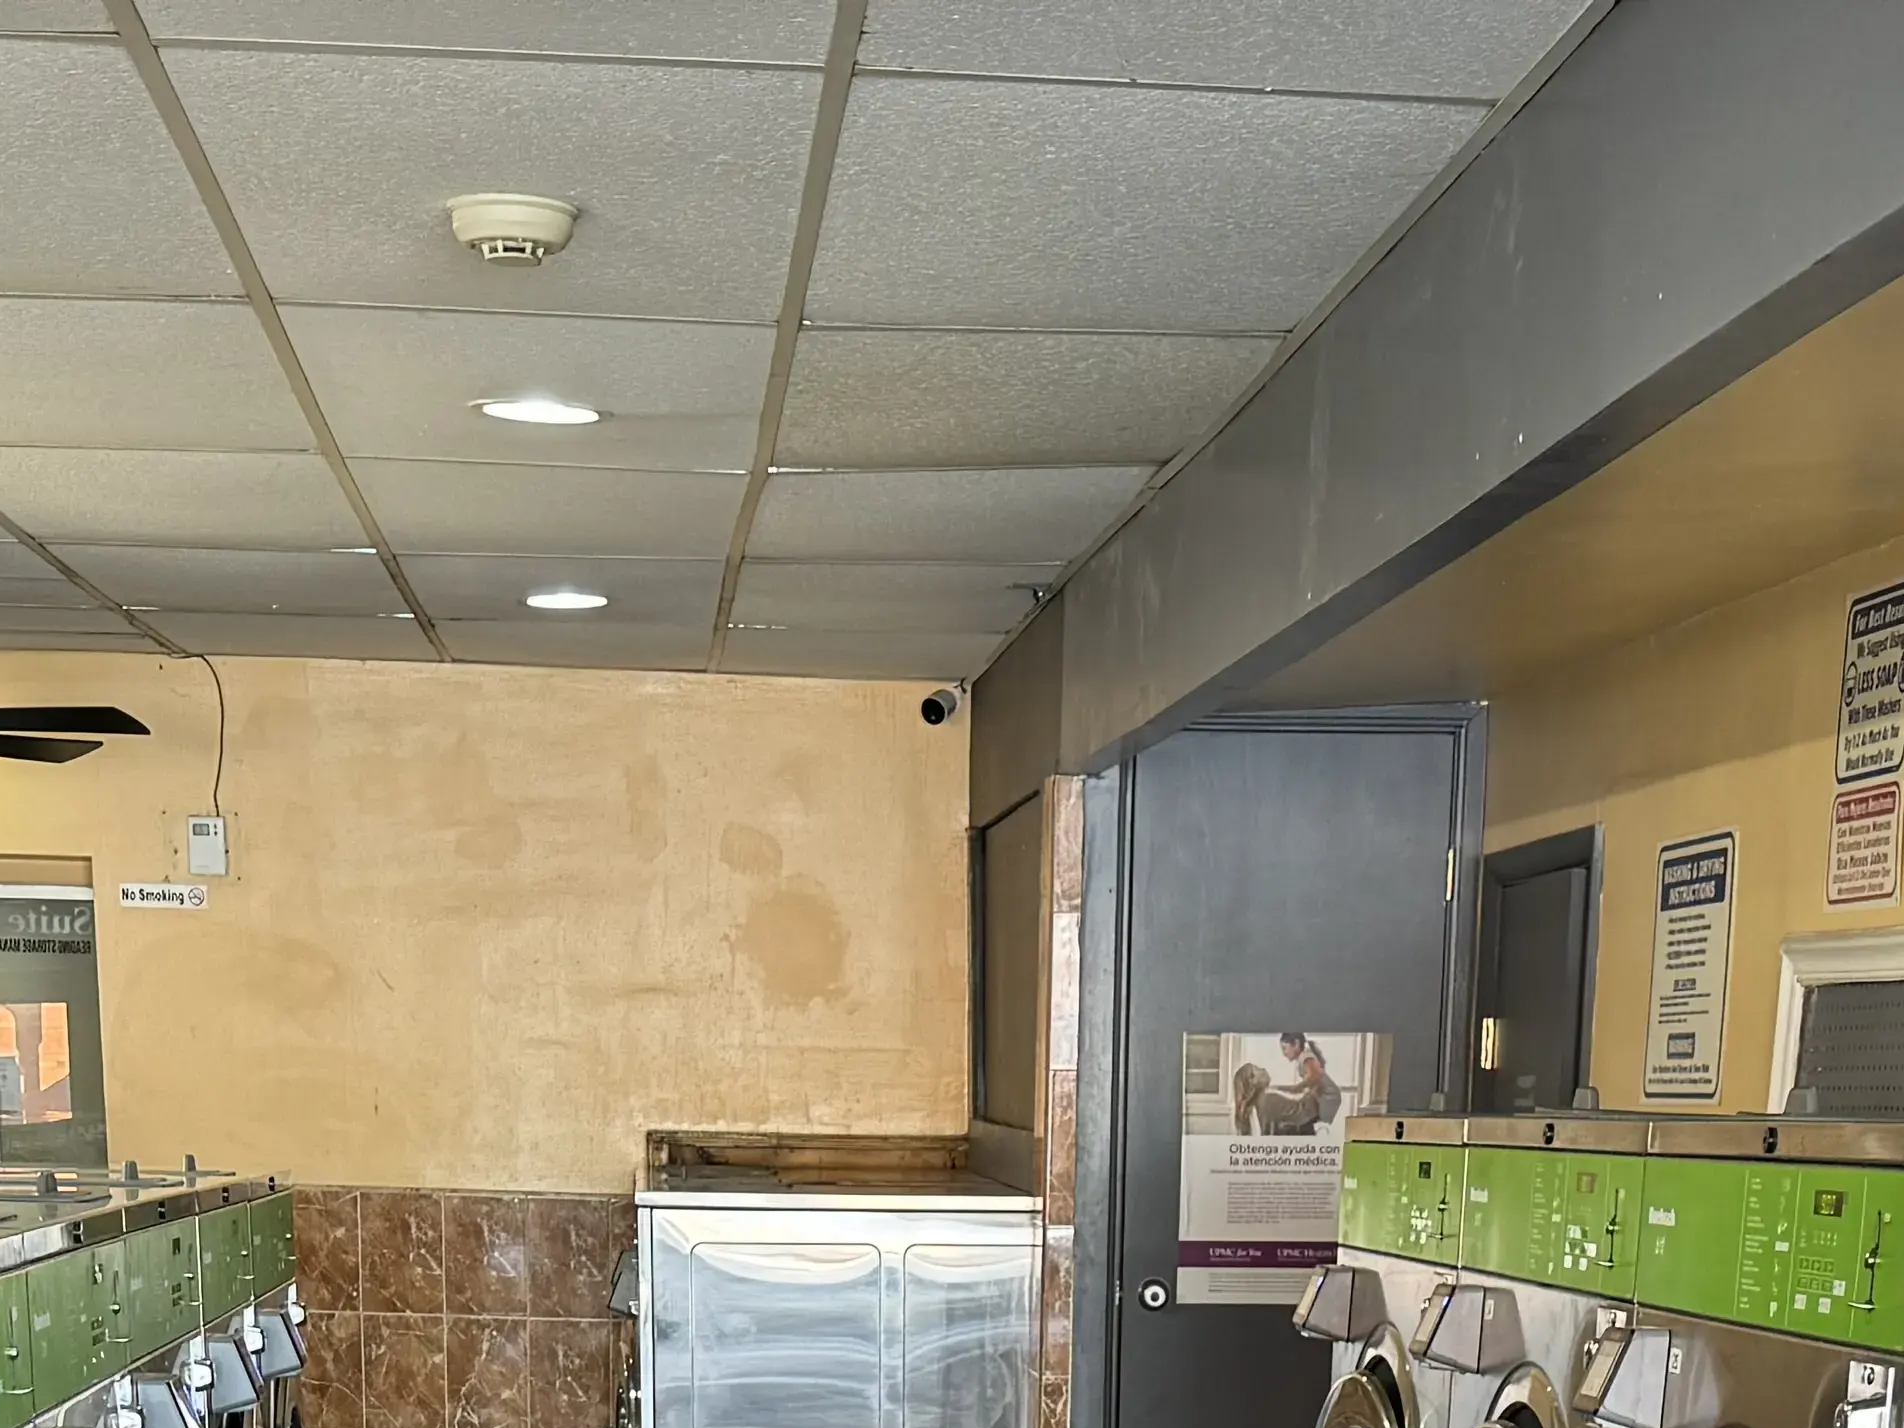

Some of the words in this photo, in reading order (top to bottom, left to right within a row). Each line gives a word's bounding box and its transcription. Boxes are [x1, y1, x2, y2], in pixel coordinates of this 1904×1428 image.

[1868, 608, 1884, 629] Best
[1858, 667, 1875, 695] LESS
[122, 887, 136, 901] No
[139, 888, 185, 905] Smoking
[1229, 1143, 1279, 1156] Obtenga
[1281, 1144, 1316, 1155] ayuda
[1319, 1145, 1340, 1154] con
[1229, 1156, 1239, 1166] la
[1242, 1156, 1291, 1166] atención
[1294, 1156, 1339, 1166] médica.
